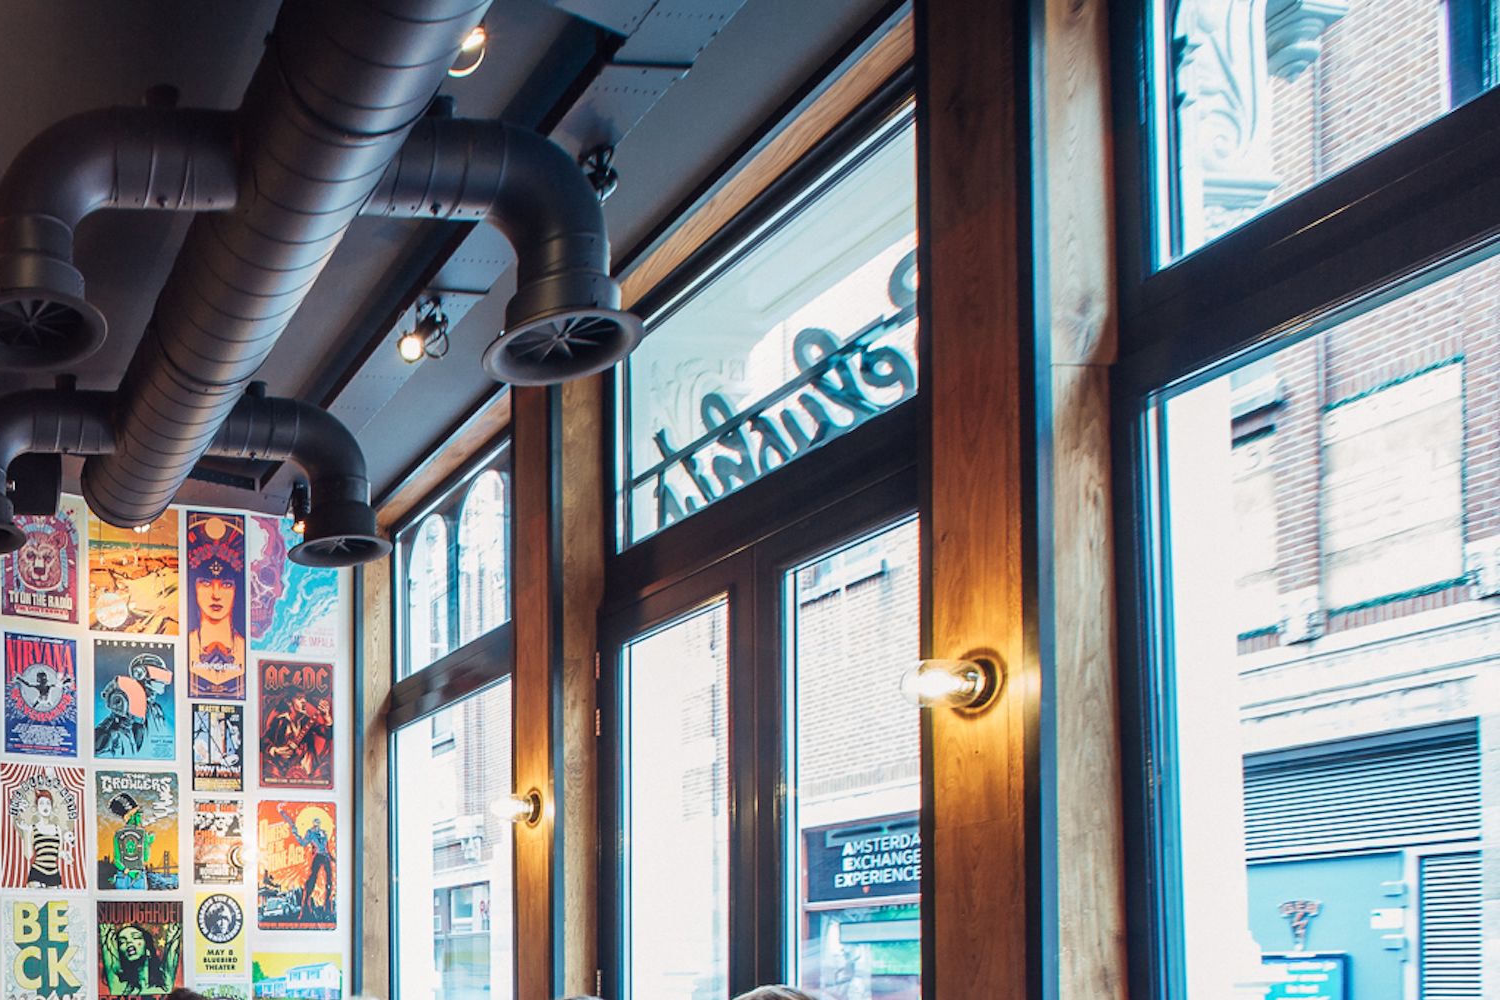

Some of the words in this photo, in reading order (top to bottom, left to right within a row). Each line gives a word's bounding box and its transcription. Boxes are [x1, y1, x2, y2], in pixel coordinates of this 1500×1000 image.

[32, 592, 48, 607] THE
[97, 640, 173, 650] DISCOVERY
[309, 636, 335, 649] IMPALA
[6, 639, 76, 690] NIRVANA
[842, 832, 922, 857] AMSTERDA
[842, 848, 922, 872] EXCHANGE
[834, 866, 922, 888] EXPERIENCE
[13, 900, 69, 943] BE
[99, 902, 184, 924] SOUNDGARDEN
[13, 944, 80, 990] CK
